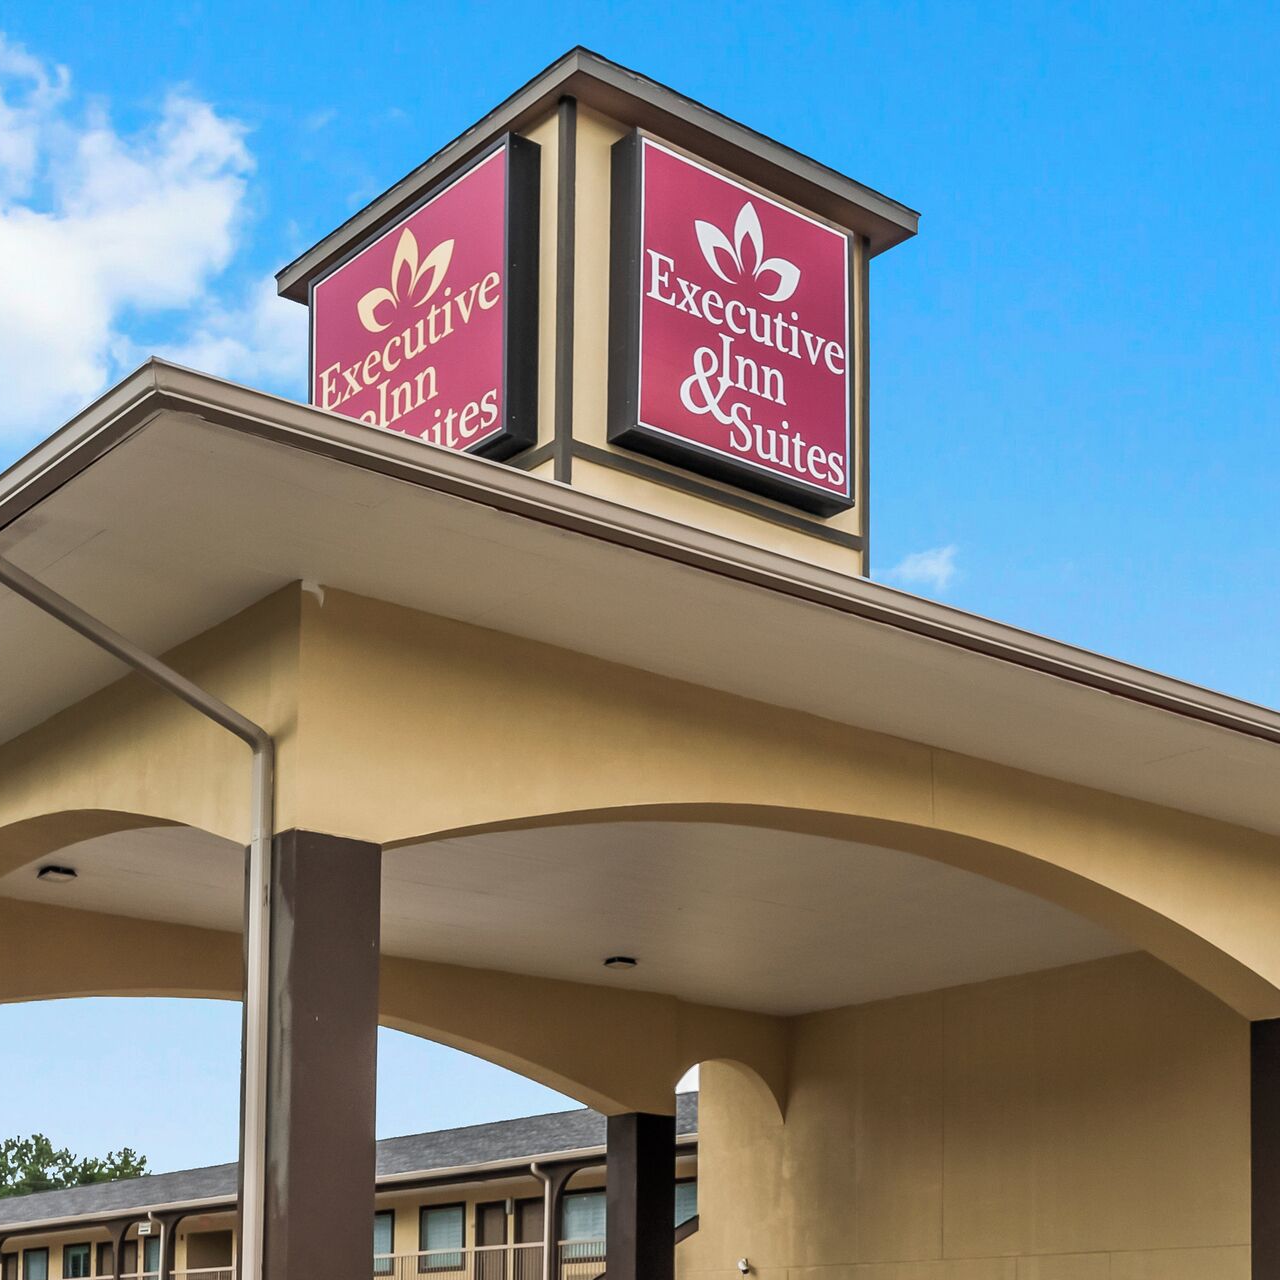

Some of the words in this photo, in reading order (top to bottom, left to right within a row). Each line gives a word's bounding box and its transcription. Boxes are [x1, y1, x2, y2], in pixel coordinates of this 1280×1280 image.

[319, 271, 501, 412] Executive
[646, 248, 845, 375] Executive
[376, 366, 439, 428] Inn
[679, 346, 735, 425] &
[718, 332, 787, 406] Inn
[729, 402, 845, 486] Suites
